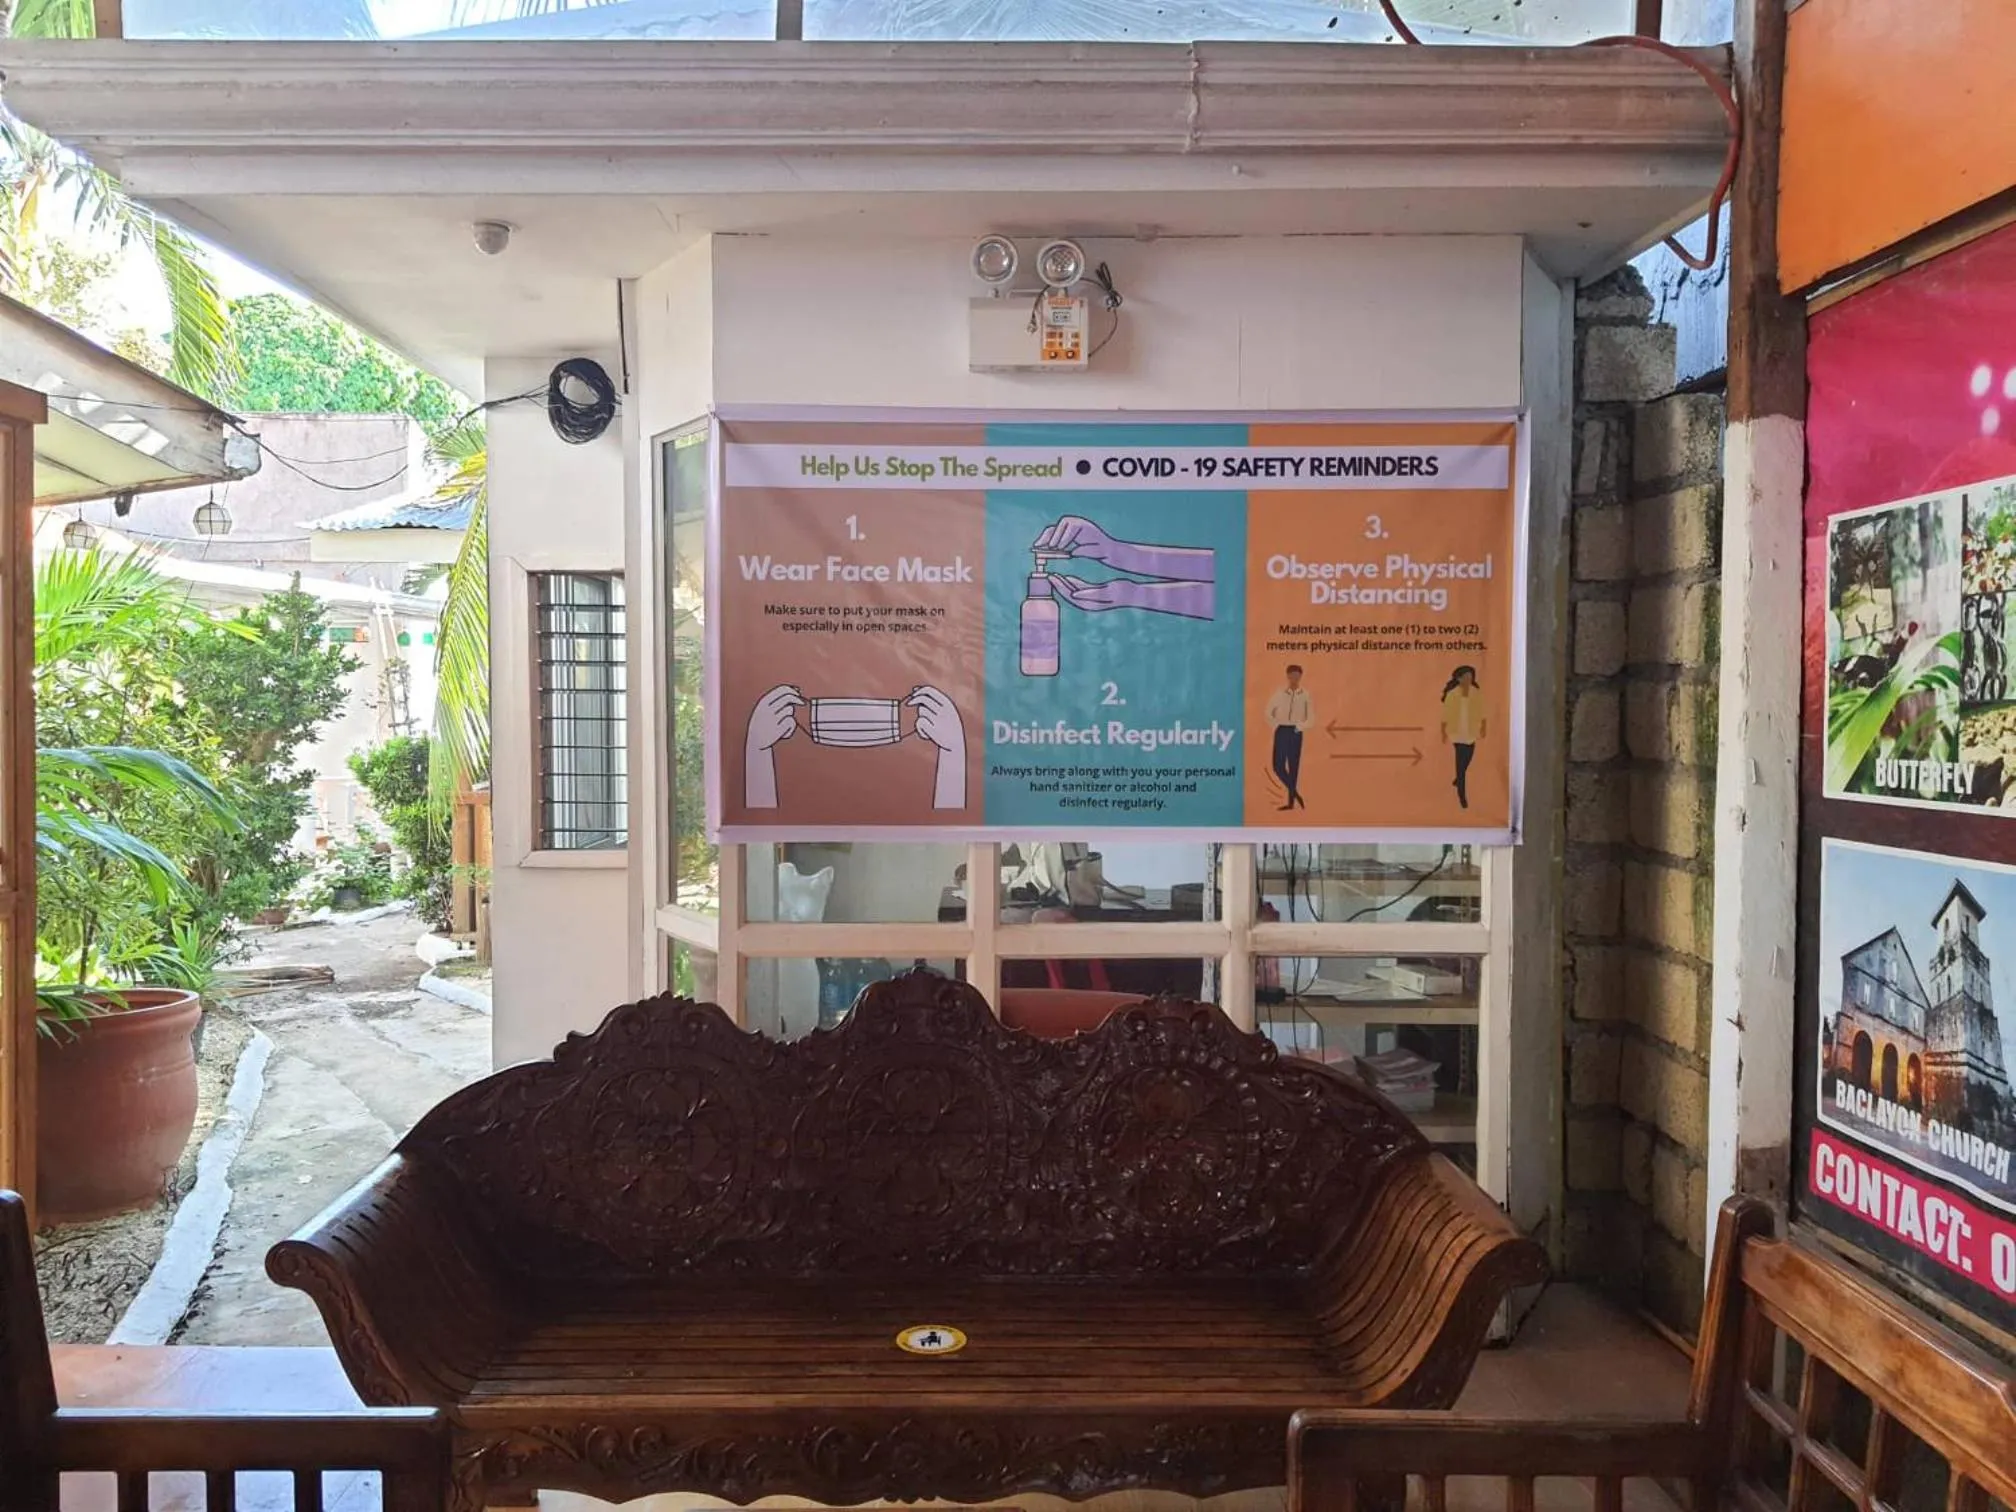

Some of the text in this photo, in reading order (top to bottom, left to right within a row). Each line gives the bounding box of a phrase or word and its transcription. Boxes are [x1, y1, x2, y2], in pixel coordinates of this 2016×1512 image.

[801, 455, 1062, 482] Help Us Stop The Spread
[1103, 457, 1175, 477] COVID
[1194, 457, 1217, 476] 19
[1222, 457, 1304, 477] SAFETY
[1309, 456, 1439, 477] REMINDERS
[845, 515, 866, 540] 1.
[1364, 515, 1389, 539] 3.
[738, 555, 973, 583] Wear Face Mask
[1267, 554, 1492, 585] Observe Physical
[1311, 581, 1448, 611] Distancing
[764, 604, 945, 619] Make sure to put your mask on
[782, 620, 839, 633] especially
[842, 621, 853, 632] in
[856, 623, 885, 634] open
[1279, 624, 1479, 636] Maintain at least one (1) to two (2)
[1266, 640, 1487, 653] meters physical distance from others.
[1101, 682, 1127, 705] 2.
[992, 720, 1234, 751] Disinfect Regularly
[991, 765, 1236, 780] Always bring along with you your personal
[1875, 758, 1976, 795] BUTTERFLY
[1030, 782, 1197, 793] hand sanitizer or alcohol and
[1059, 797, 1167, 811] disinfect regularly.
[1835, 1078, 2011, 1185] BACLAYON CHURCH
[1815, 1142, 1973, 1273] CONTACT:
